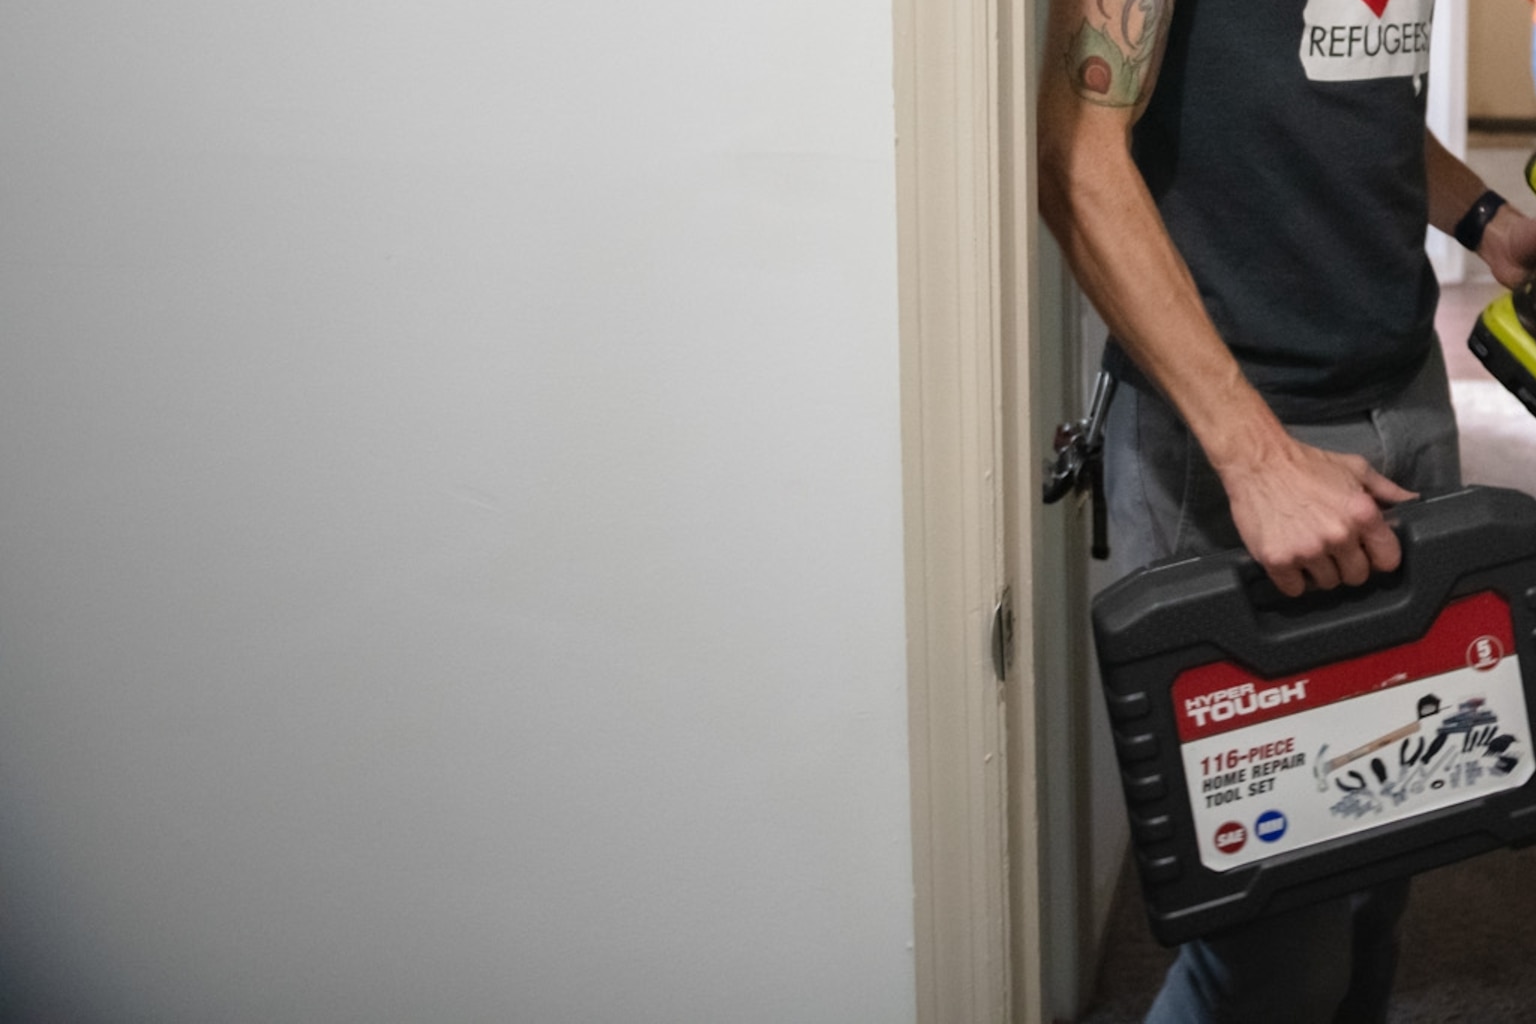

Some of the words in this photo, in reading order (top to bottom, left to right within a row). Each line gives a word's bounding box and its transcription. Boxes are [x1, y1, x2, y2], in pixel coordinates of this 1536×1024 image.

[1309, 22, 1428, 57] REFUGEES
[1184, 682, 1255, 711] HYPER
[1187, 680, 1308, 727] TOUGH
[1201, 737, 1295, 776] 116-PIECE
[1202, 769, 1246, 793] HOME
[1252, 752, 1306, 779] REPAIR
[1206, 787, 1242, 808] TOOL
[1248, 777, 1275, 796] SET
